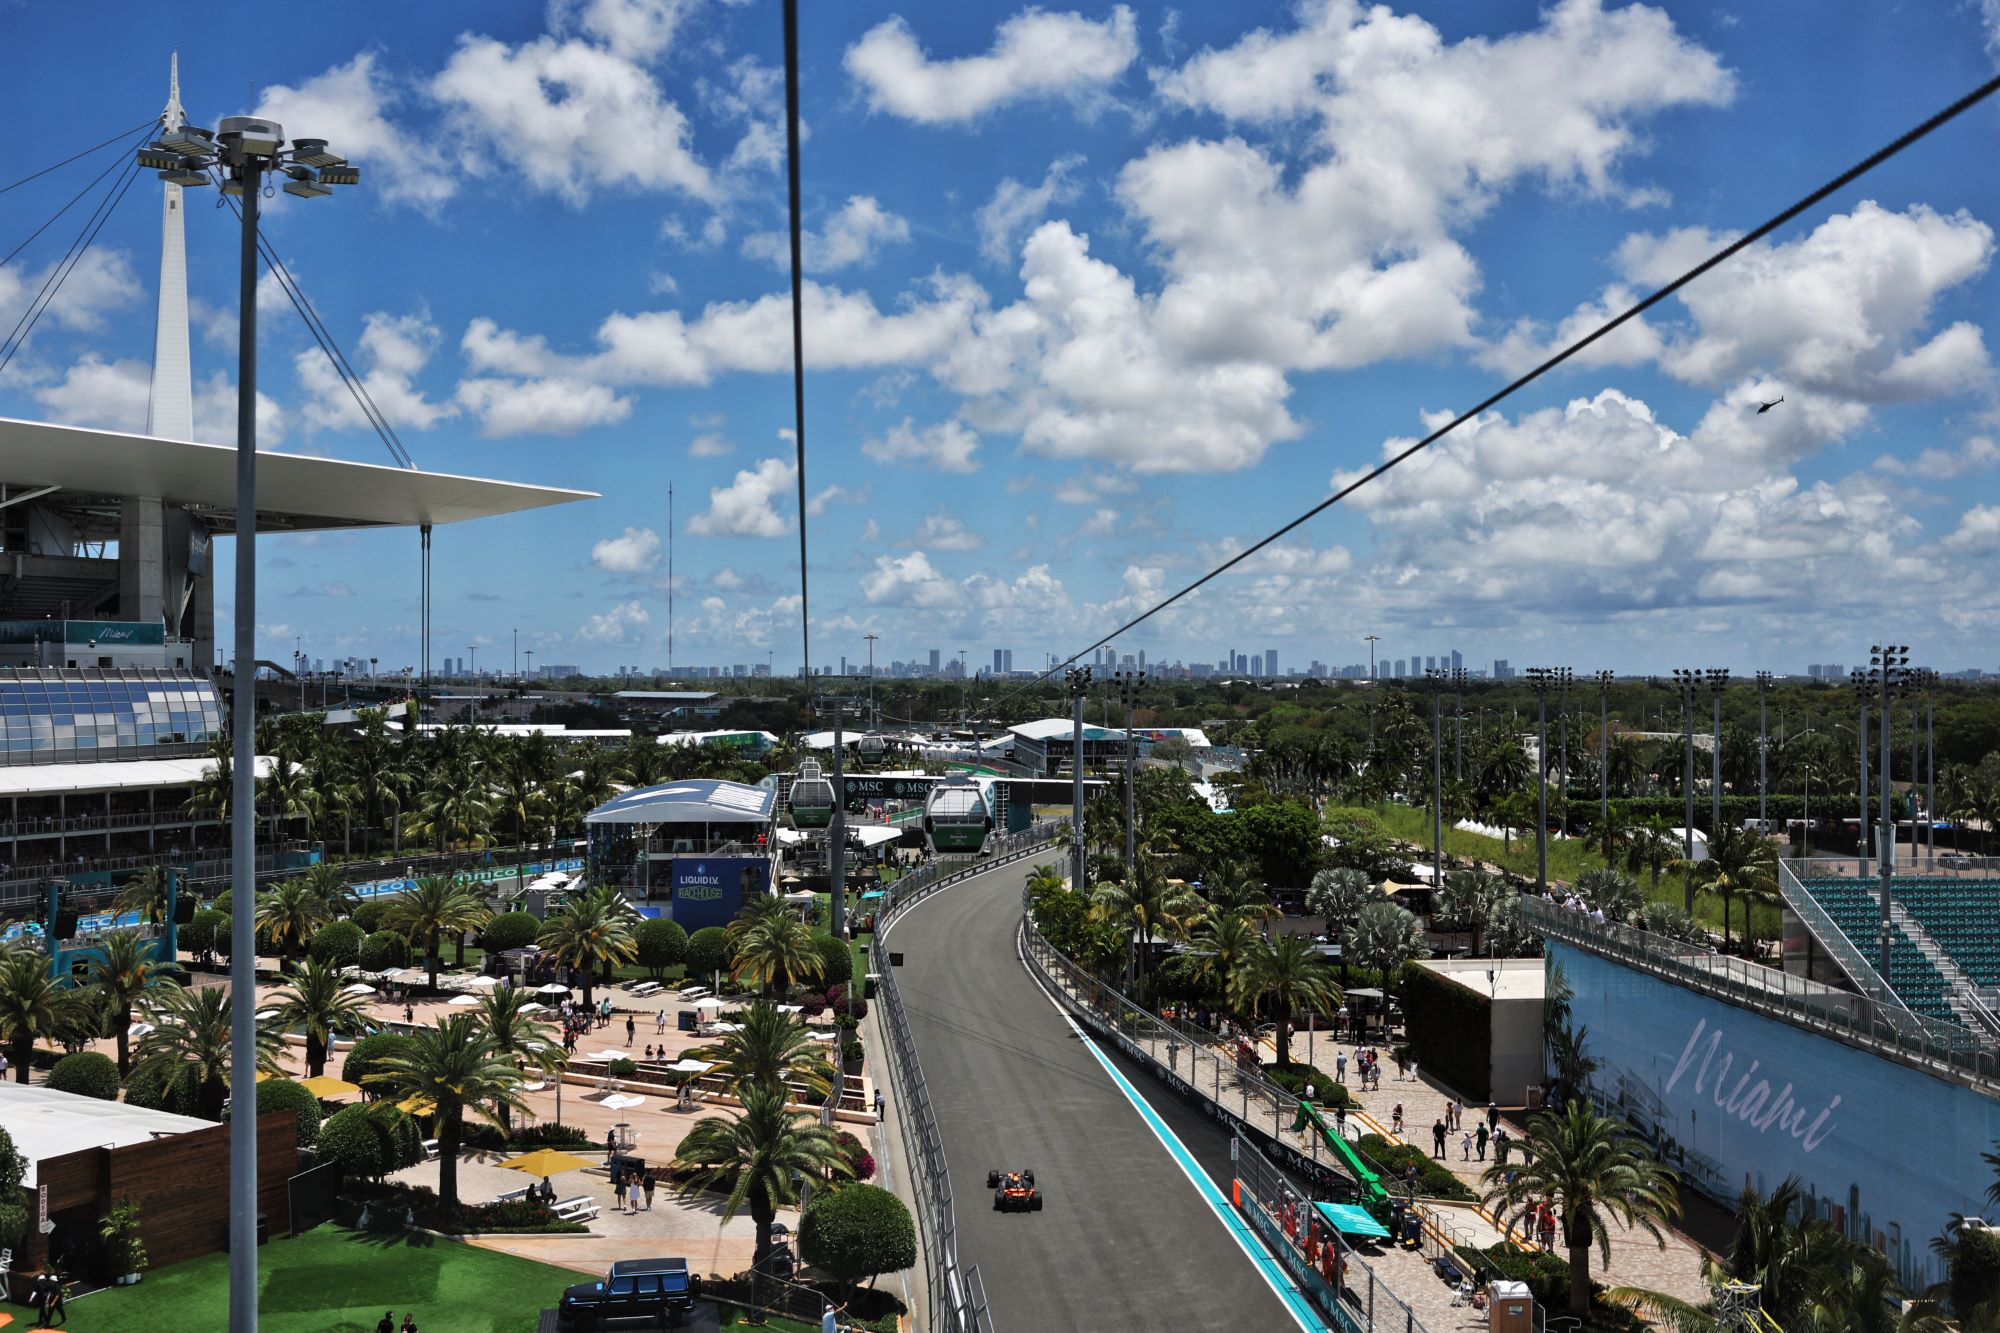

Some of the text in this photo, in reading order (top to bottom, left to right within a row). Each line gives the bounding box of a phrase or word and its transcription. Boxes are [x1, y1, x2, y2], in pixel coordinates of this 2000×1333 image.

[99, 627, 134, 639] Miami
[858, 782, 884, 792] MSC
[680, 876, 708, 884] LIQUID
[1126, 1043, 1145, 1063] MSC
[1167, 1073, 1189, 1096] MSC
[1665, 1018, 1842, 1152] Miami
[1216, 1109, 1246, 1133] MSC
[1286, 1150, 1328, 1179] MSC
[1252, 1209, 1270, 1234] MSC
[1288, 1250, 1308, 1282] MSC
[1330, 1304, 1352, 1333] MSC
